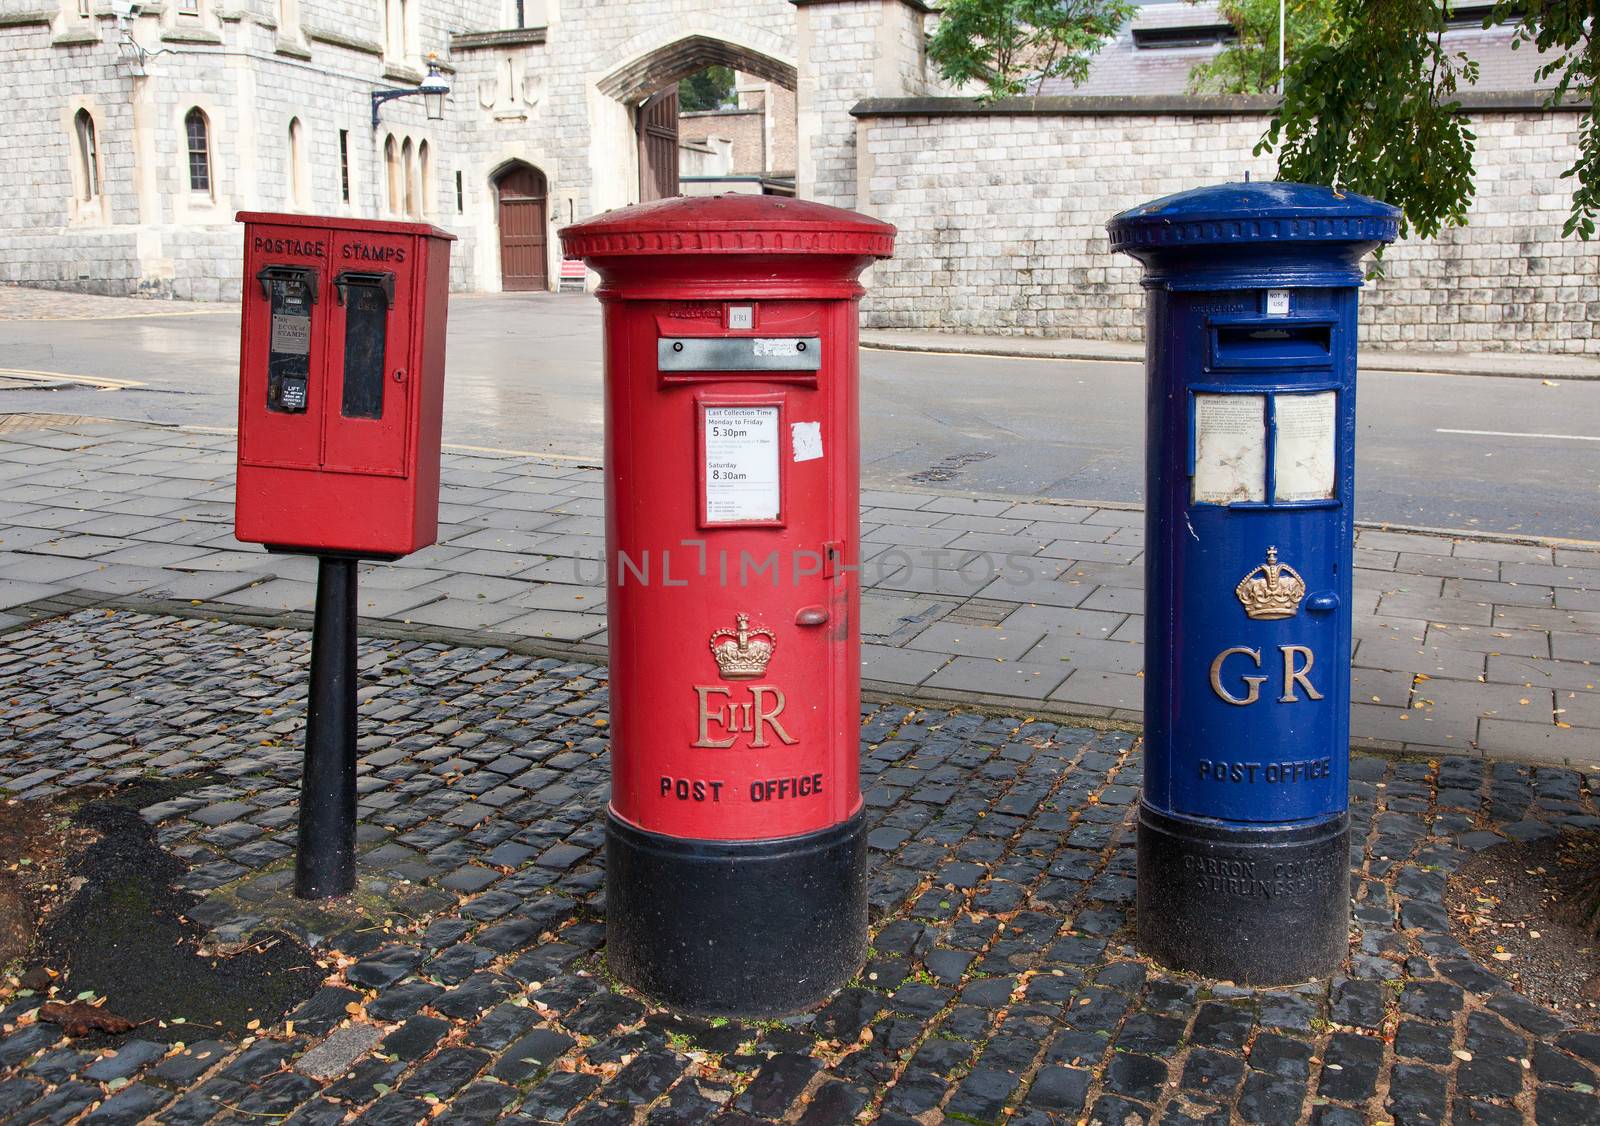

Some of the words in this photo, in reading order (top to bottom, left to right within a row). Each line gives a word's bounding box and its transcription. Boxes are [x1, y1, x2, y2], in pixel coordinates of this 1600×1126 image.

[254, 237, 325, 258] POSTAGE
[342, 244, 406, 263] STAMPS
[733, 313, 747, 321] FRI
[712, 426, 747, 438] 5.30pm
[712, 469, 747, 480] 8.30am
[1199, 758, 1261, 784] POST
[1265, 756, 1330, 784] OFFICE
[660, 775, 724, 802] POST
[750, 773, 823, 802] OFFICE
[1183, 855, 1257, 880] CARRON
